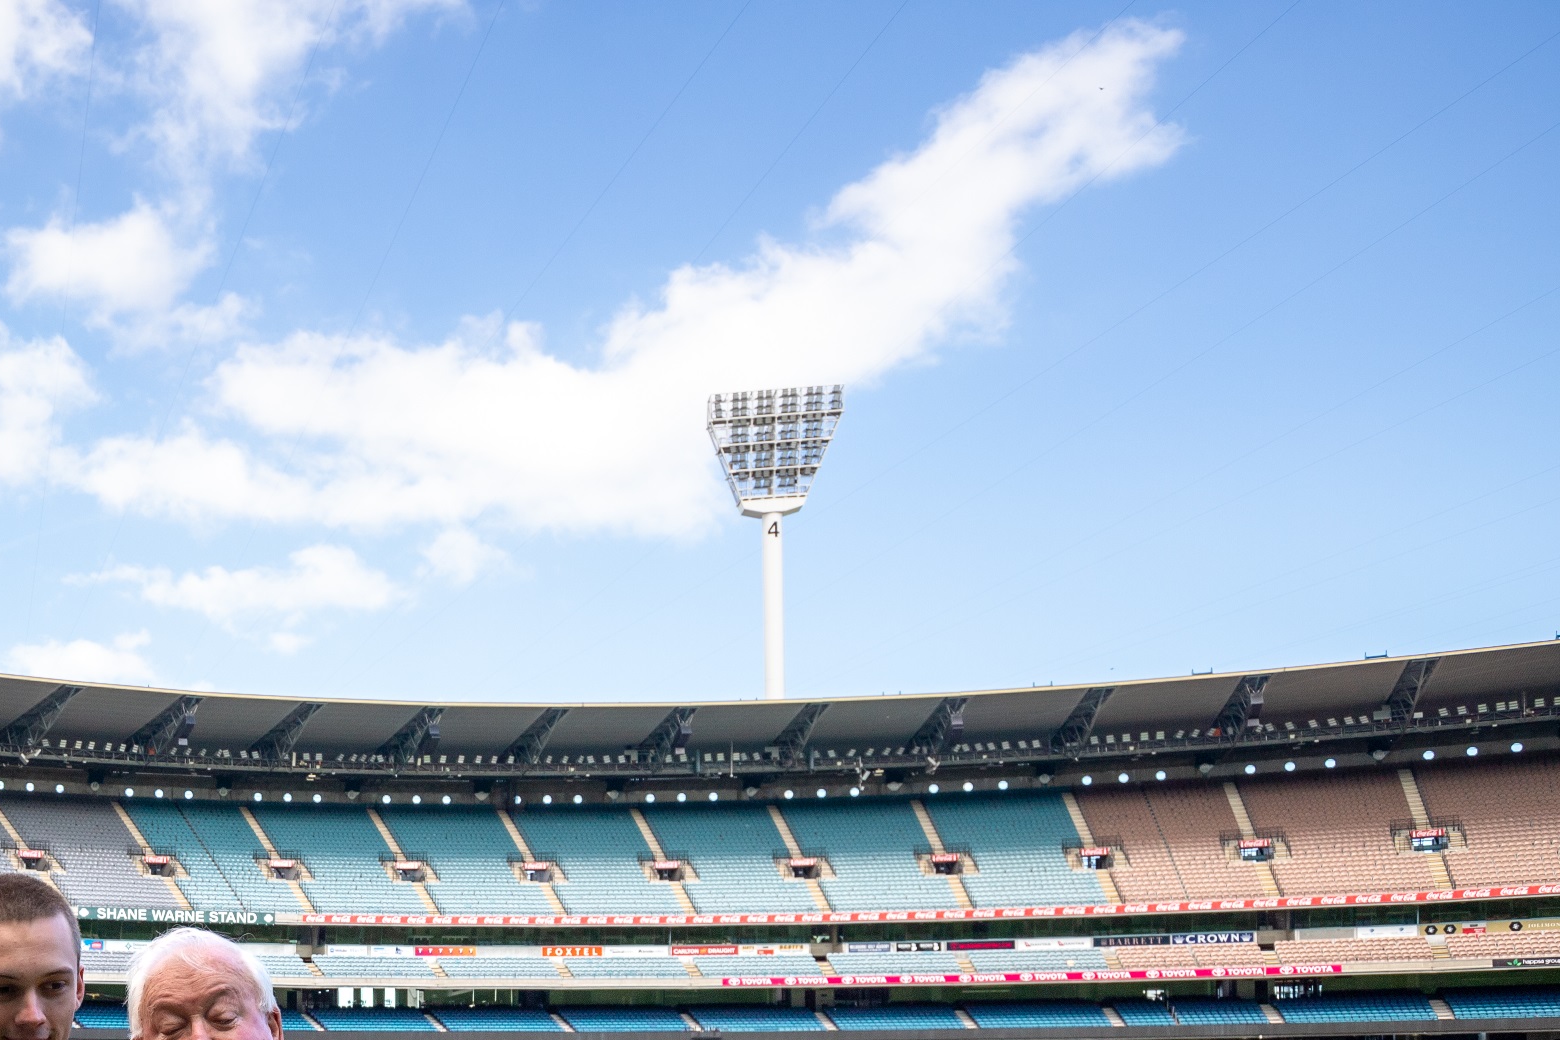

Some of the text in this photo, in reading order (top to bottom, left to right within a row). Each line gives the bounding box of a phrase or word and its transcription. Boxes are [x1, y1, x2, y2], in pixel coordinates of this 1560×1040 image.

[768, 521, 780, 538] 4
[96, 908, 258, 924] SHANE WARNE STAND
[1109, 936, 1162, 946] BARRETT
[1186, 934, 1240, 944] CROWN
[546, 948, 598, 956] FOXTEL
[1097, 971, 1130, 979] TOYOTA
[1162, 969, 1196, 977] TOYOTA
